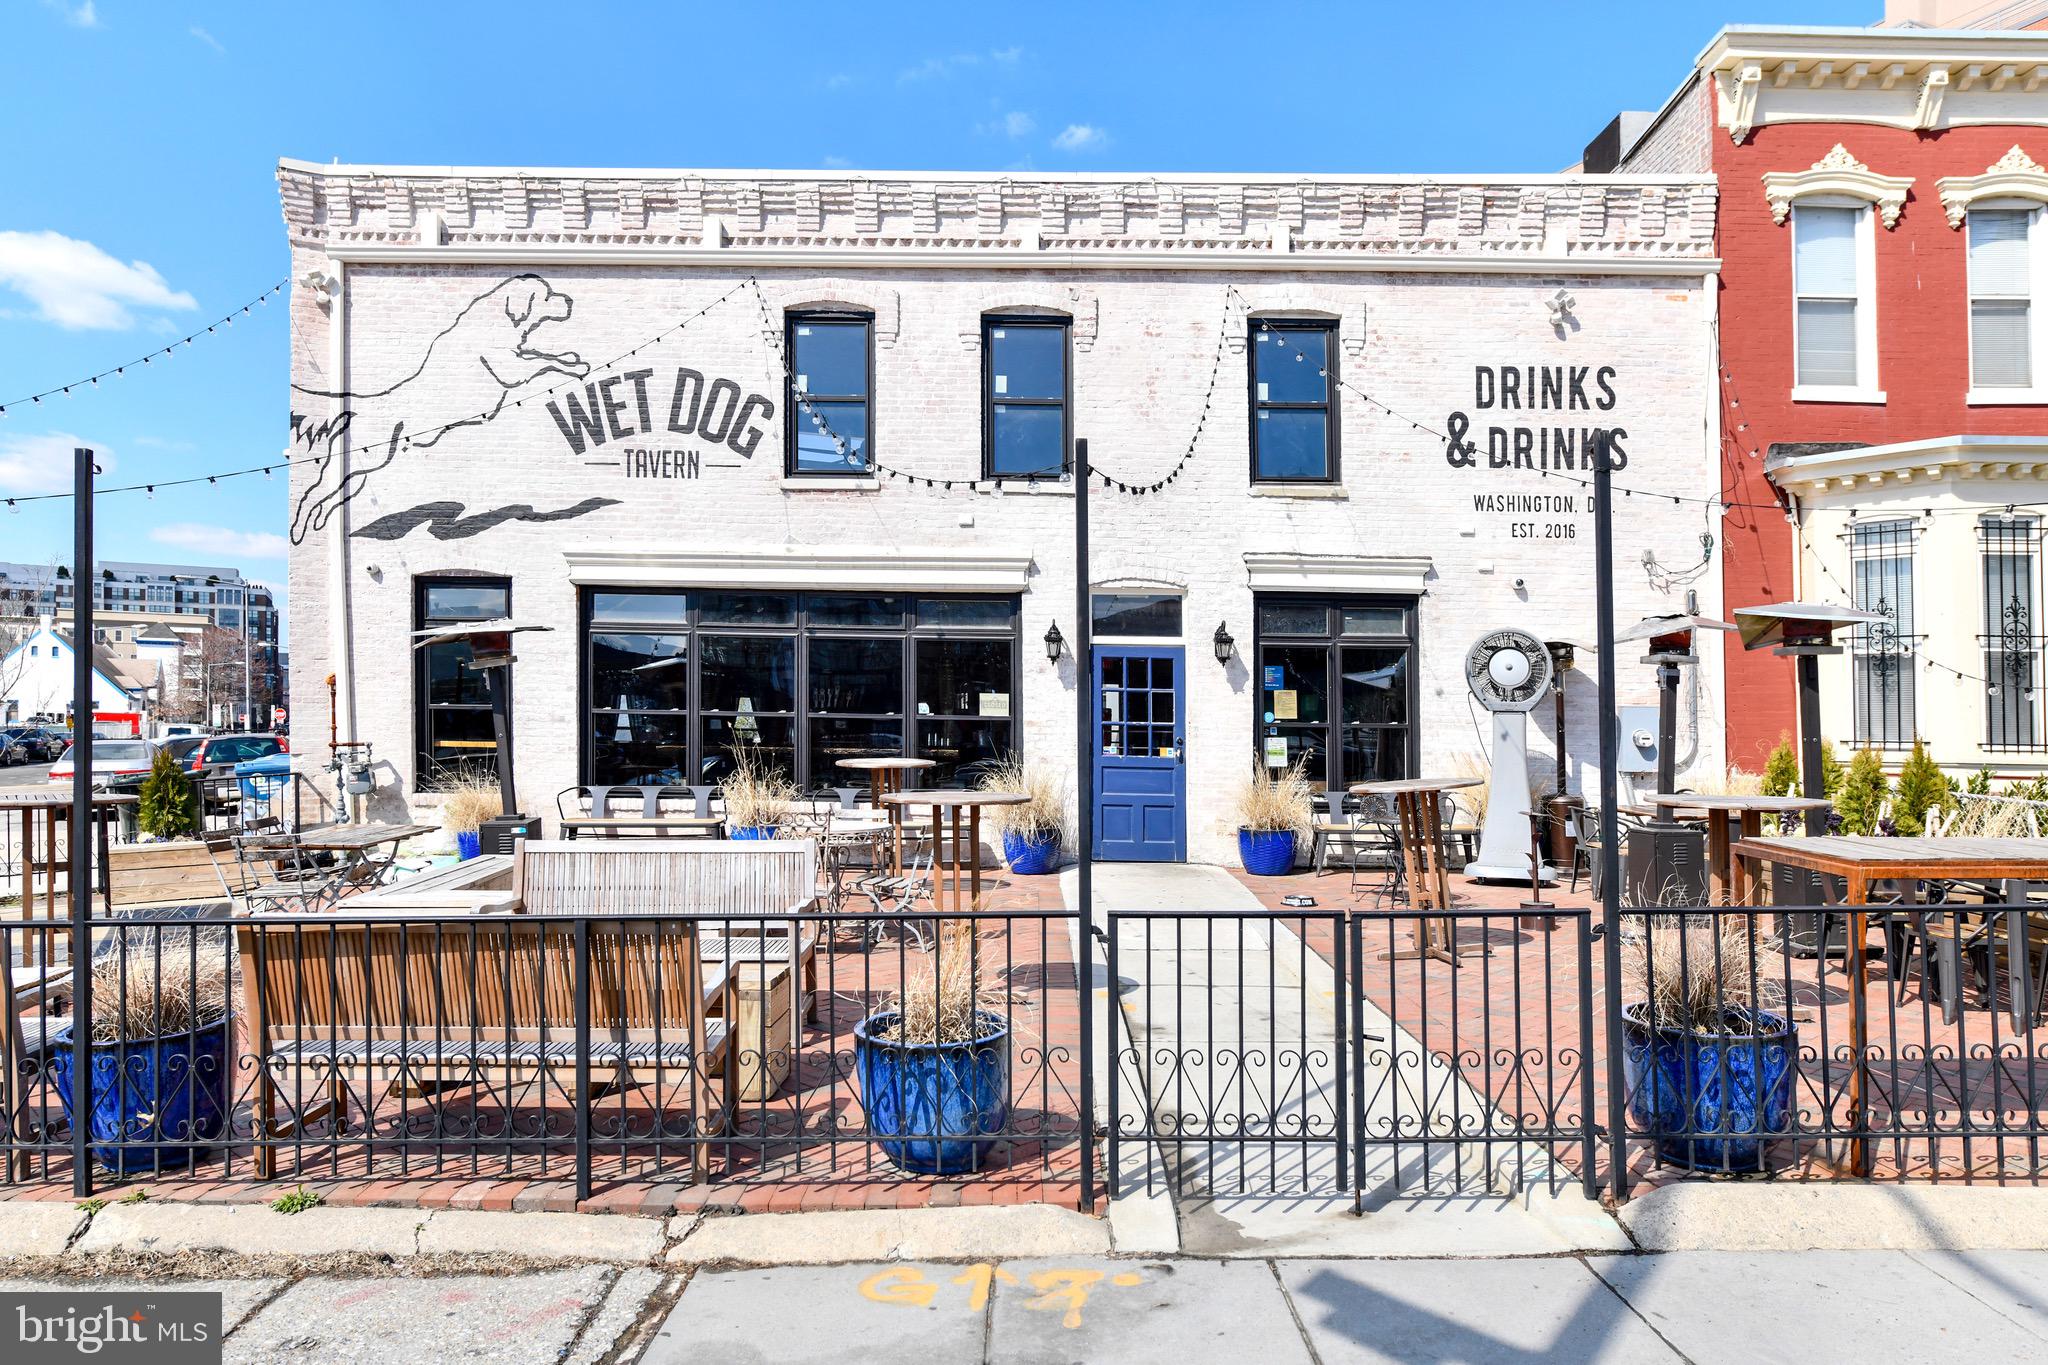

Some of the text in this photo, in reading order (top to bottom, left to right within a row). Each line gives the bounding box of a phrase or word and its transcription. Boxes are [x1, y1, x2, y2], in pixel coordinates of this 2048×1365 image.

[1475, 365, 1616, 411] DRINKS
[546, 367, 775, 460] WET DOG
[1446, 411, 1477, 468] &
[623, 448, 700, 480] TAVERN
[1511, 522, 1576, 539] EST. 2016
